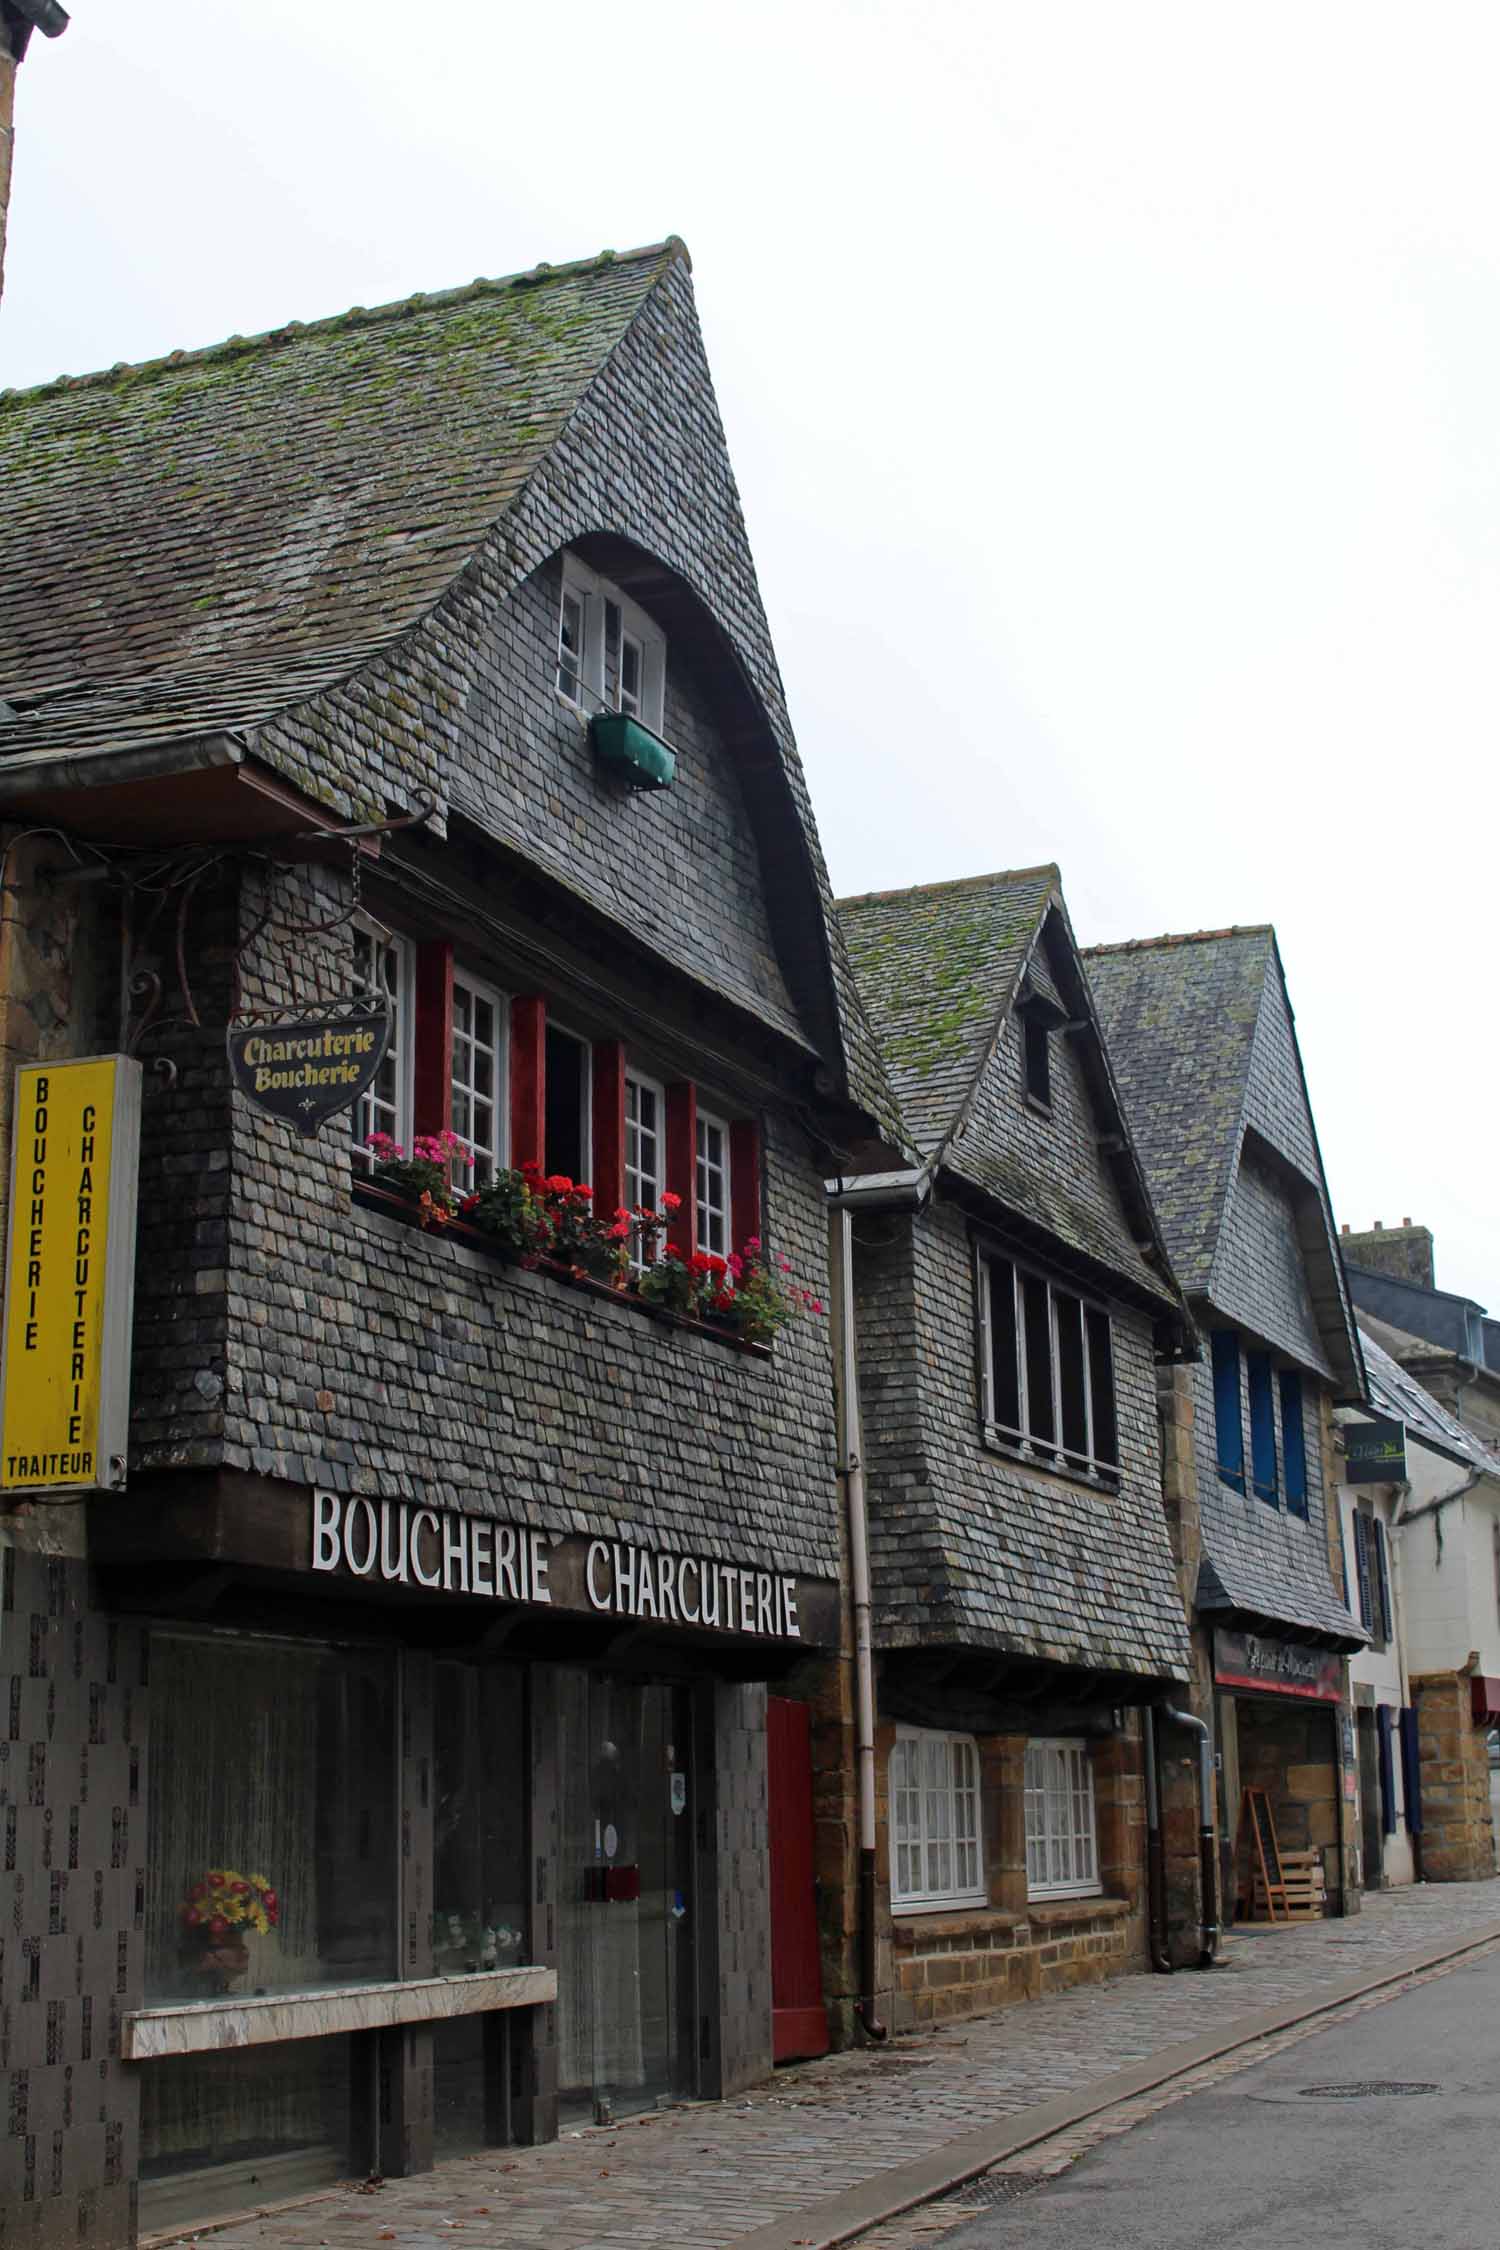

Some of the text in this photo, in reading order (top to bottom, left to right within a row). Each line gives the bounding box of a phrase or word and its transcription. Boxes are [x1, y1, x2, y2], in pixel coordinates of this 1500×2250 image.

[243, 1026, 375, 1066] Charcuterie
[254, 1059, 361, 1093] Boucherie
[25, 1077, 49, 1350] BOUCHERIE
[68, 1105, 95, 1444] CHARCUTERIE
[8, 1453, 92, 1477] TRAITEUR
[312, 1488, 800, 1637] BOUCHERIE CHARCUTERIE
